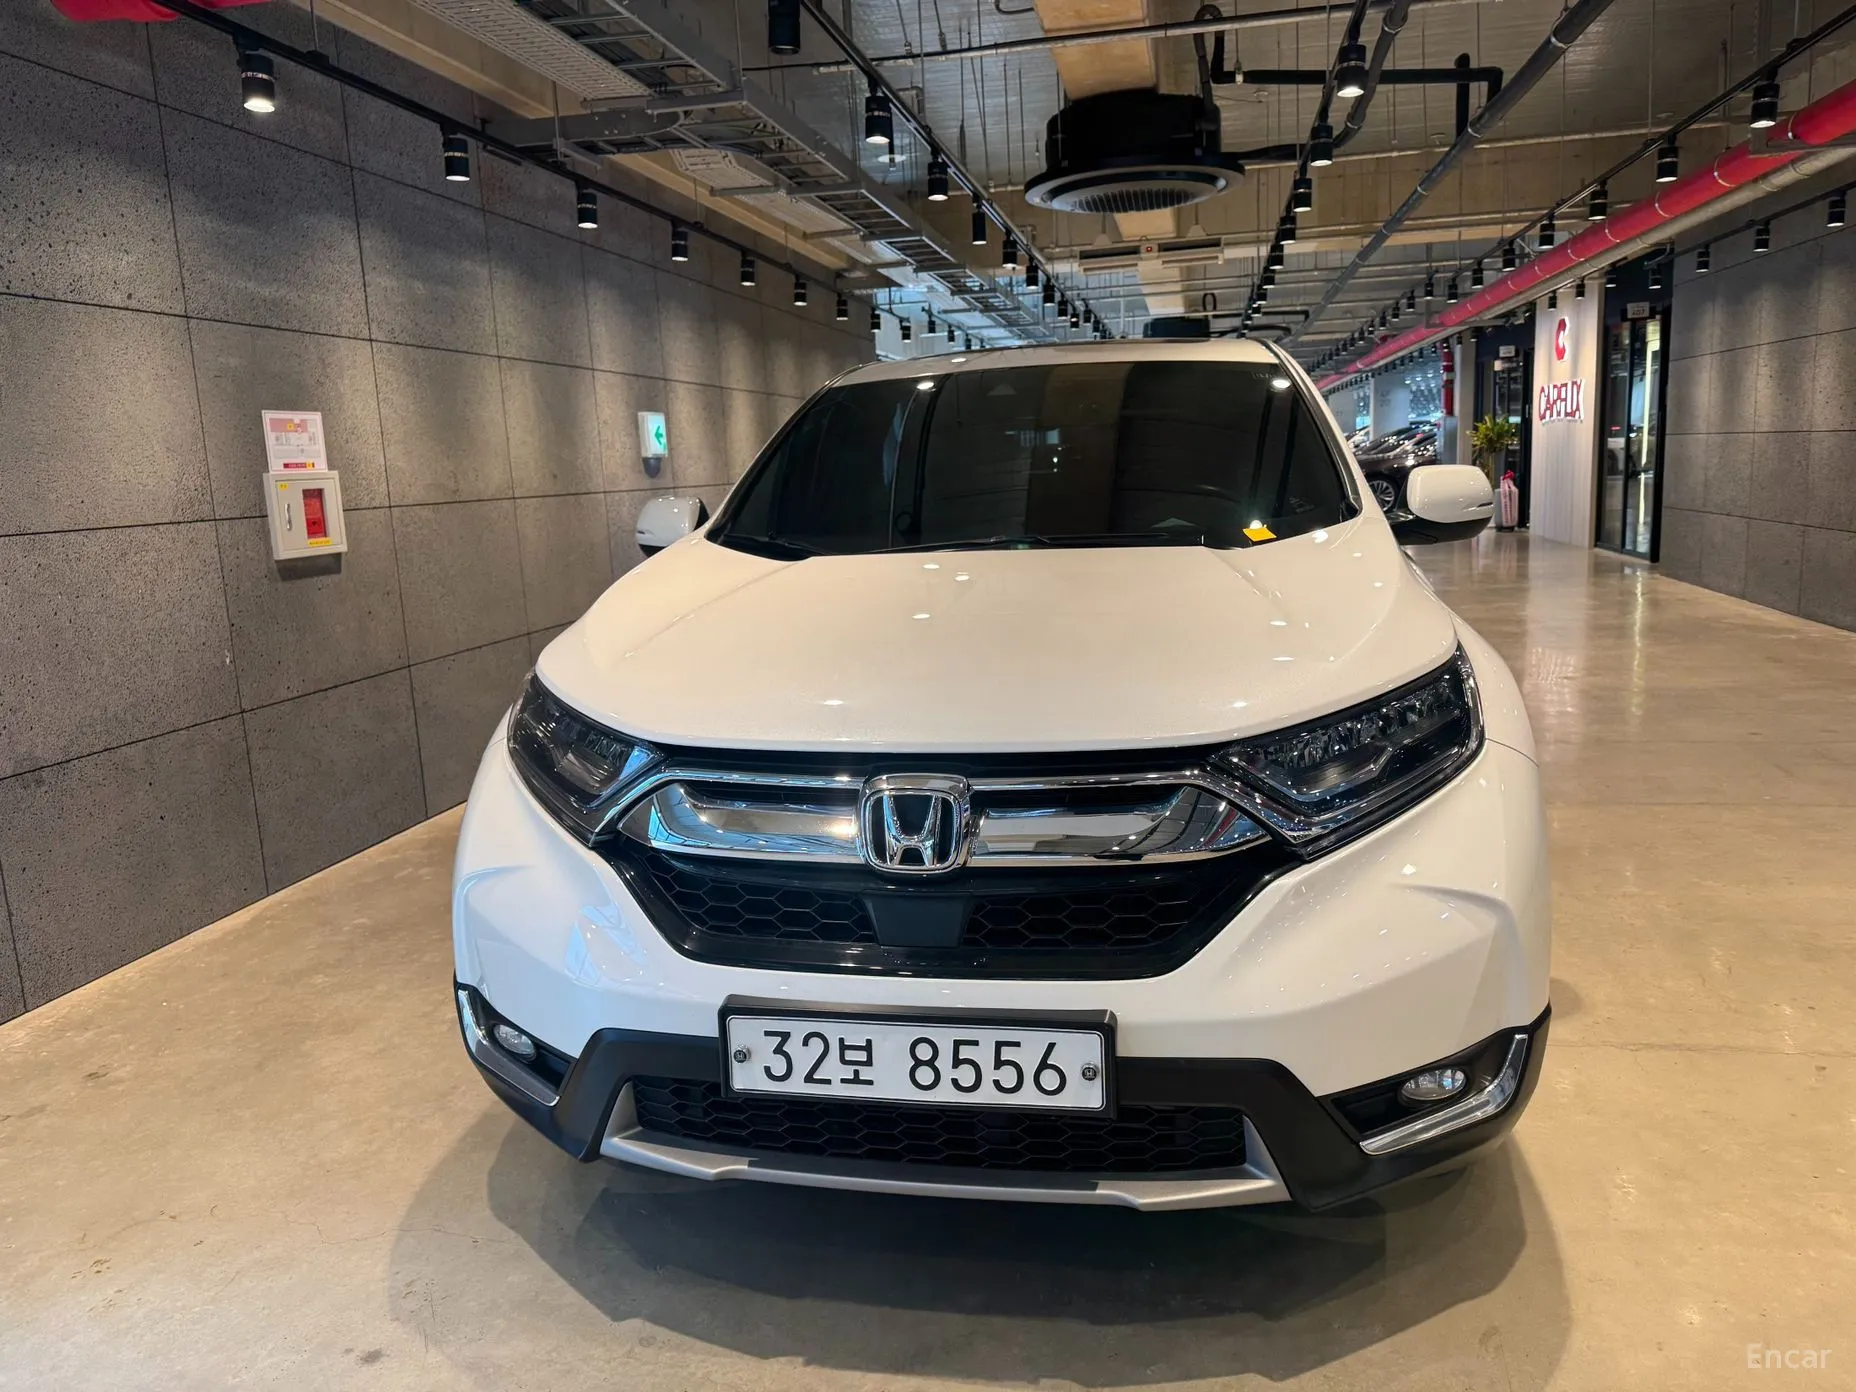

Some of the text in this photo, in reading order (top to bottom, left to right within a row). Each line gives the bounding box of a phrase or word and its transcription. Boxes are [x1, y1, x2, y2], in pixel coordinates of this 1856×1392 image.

[1539, 379, 1584, 422] CARFLIX
[763, 1029, 1067, 1097] 32보 8556
